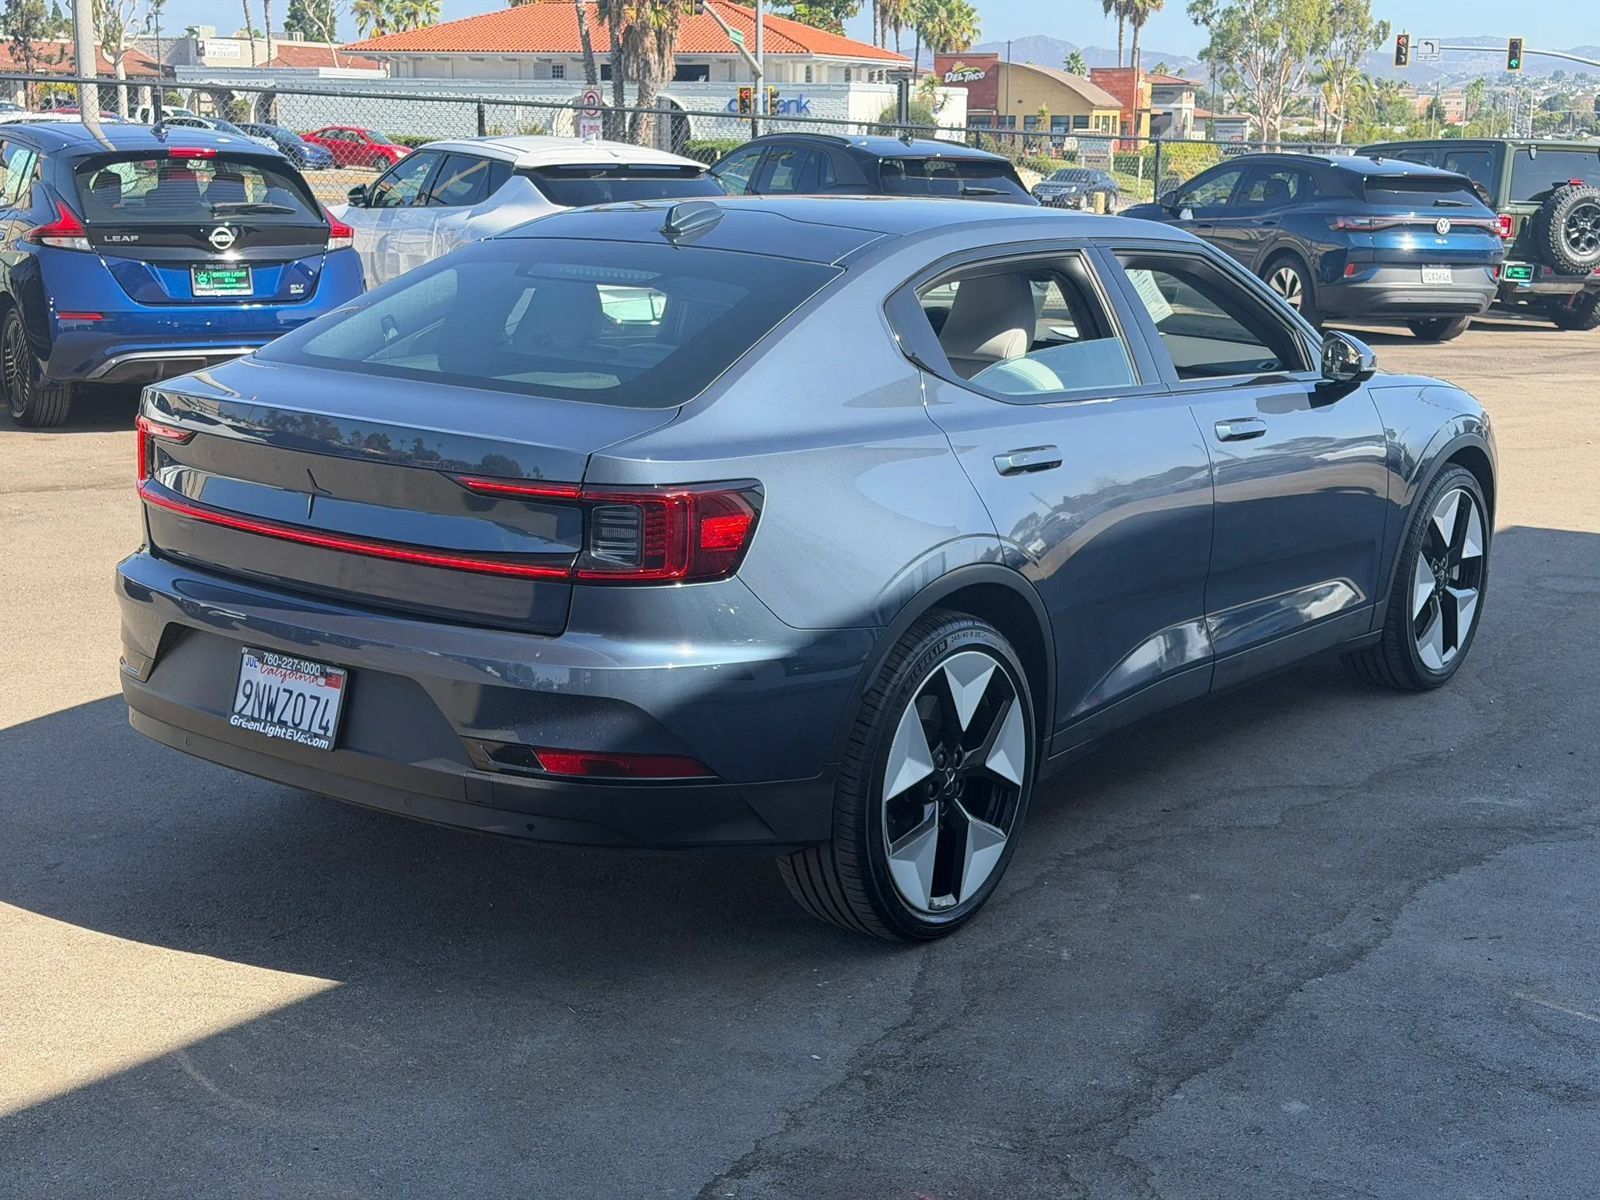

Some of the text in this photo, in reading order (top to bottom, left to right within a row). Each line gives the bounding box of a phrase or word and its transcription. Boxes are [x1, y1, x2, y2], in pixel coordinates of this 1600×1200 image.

[964, 71, 986, 83] TACO
[263, 652, 321, 676] 760-227-1000
[238, 679, 330, 737] 9NWZ074
[230, 714, 329, 749] GreenLightEVs.com
